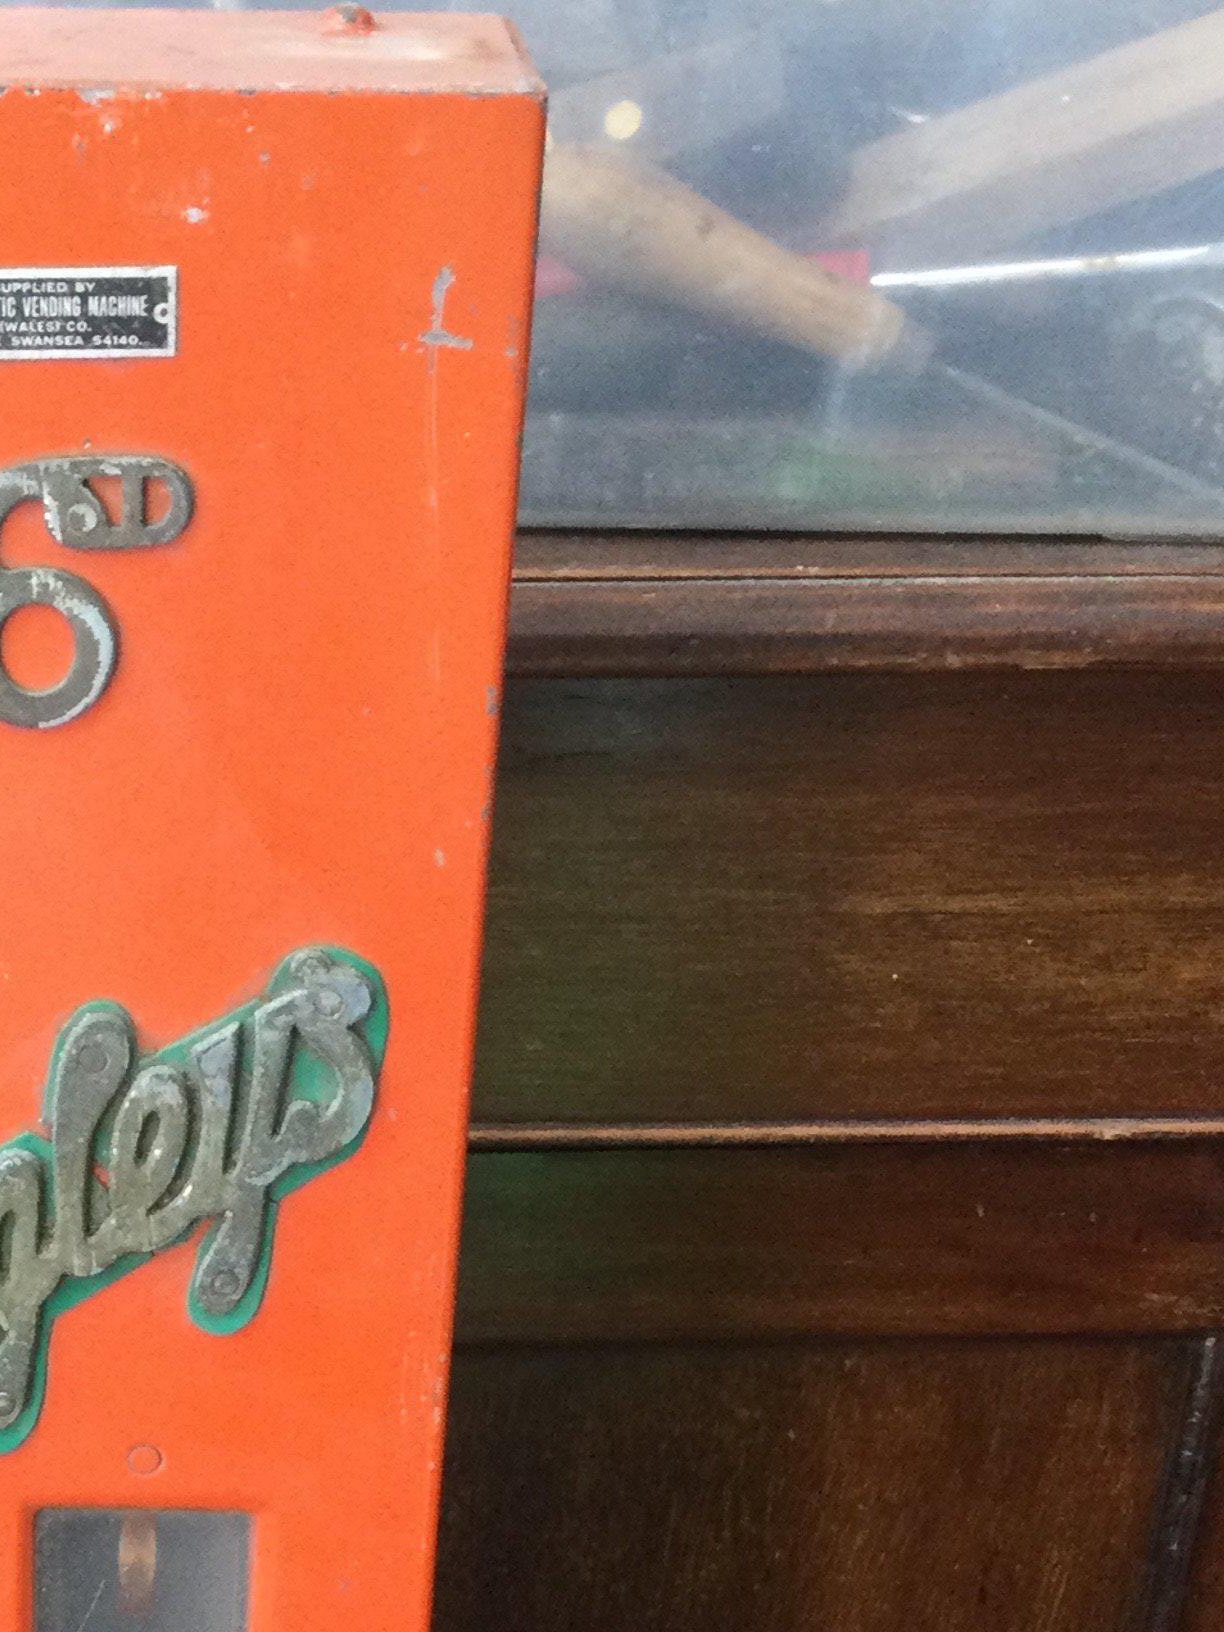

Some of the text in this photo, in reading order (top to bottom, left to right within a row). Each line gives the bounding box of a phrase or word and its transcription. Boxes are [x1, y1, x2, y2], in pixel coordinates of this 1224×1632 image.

[75, 281, 96, 292] BY
[22, 295, 82, 317] VENDING
[88, 294, 148, 317] MACHINE
[11, 335, 84, 346] SWANSEA
